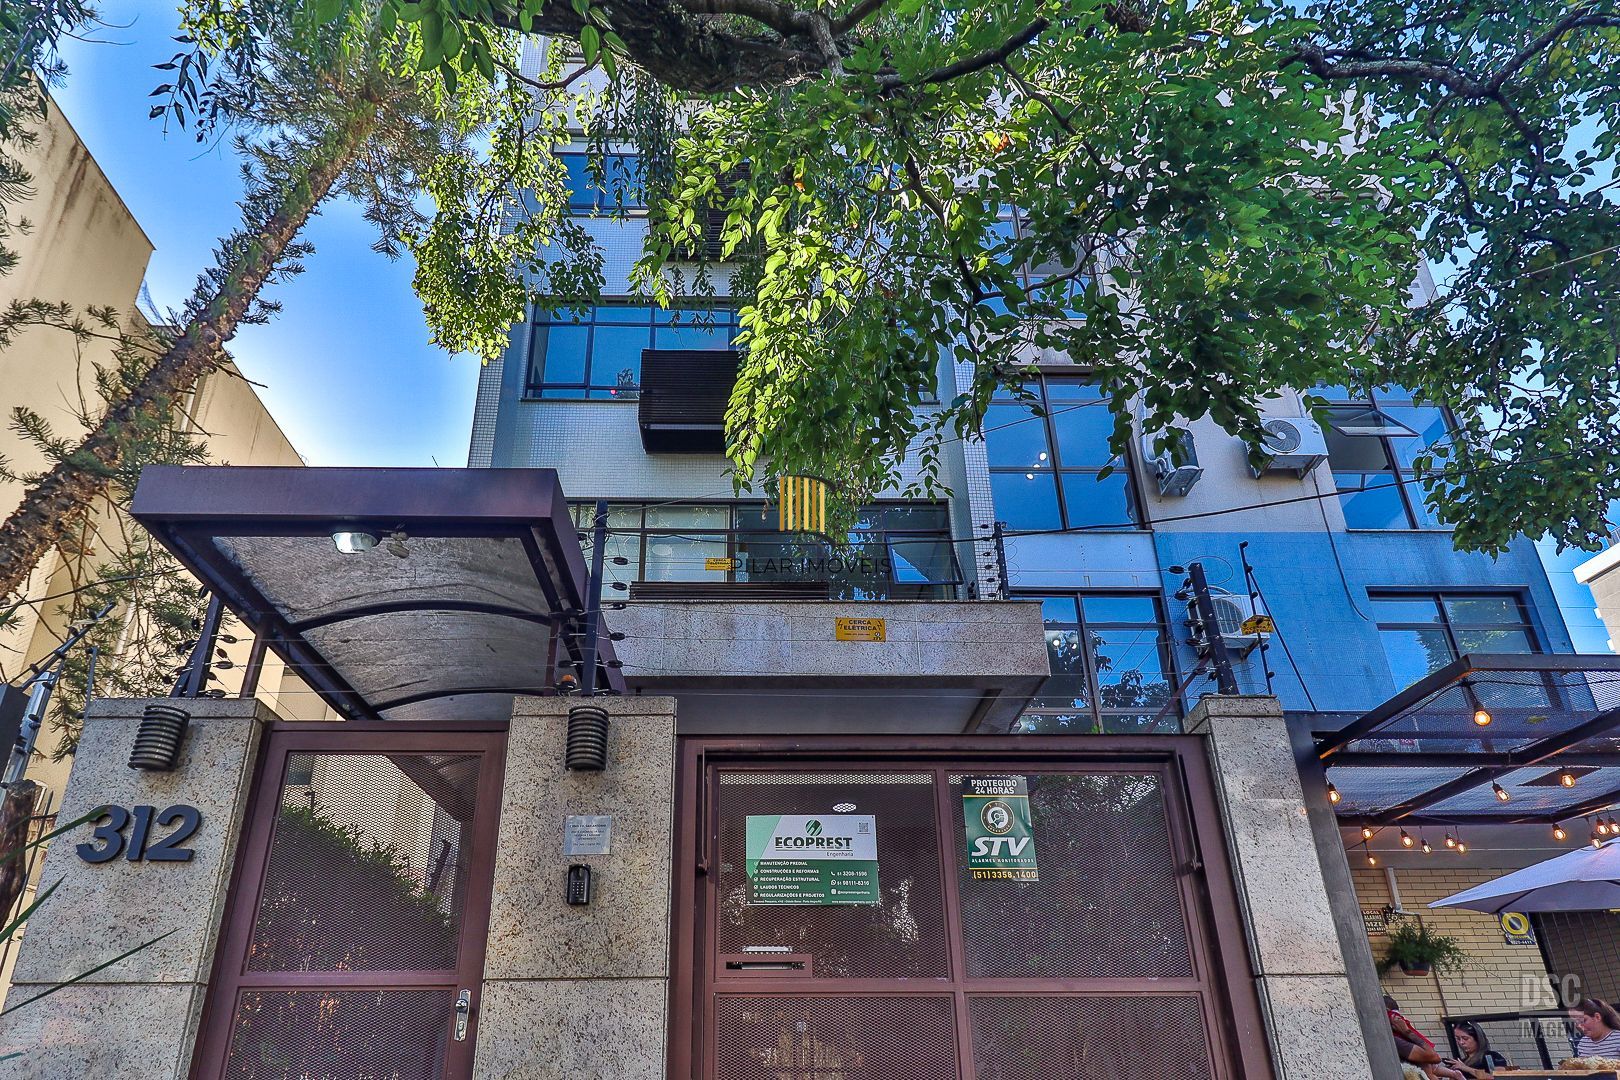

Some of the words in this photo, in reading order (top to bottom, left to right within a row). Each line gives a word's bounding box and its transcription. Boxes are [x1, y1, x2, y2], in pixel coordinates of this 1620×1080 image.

[970, 779, 1017, 788] PROTEGIDO
[975, 787, 986, 795] 24
[987, 786, 1015, 795] HORAS
[75, 804, 202, 864] 312
[774, 836, 853, 850] ECOPREST
[971, 836, 1031, 857] STV
